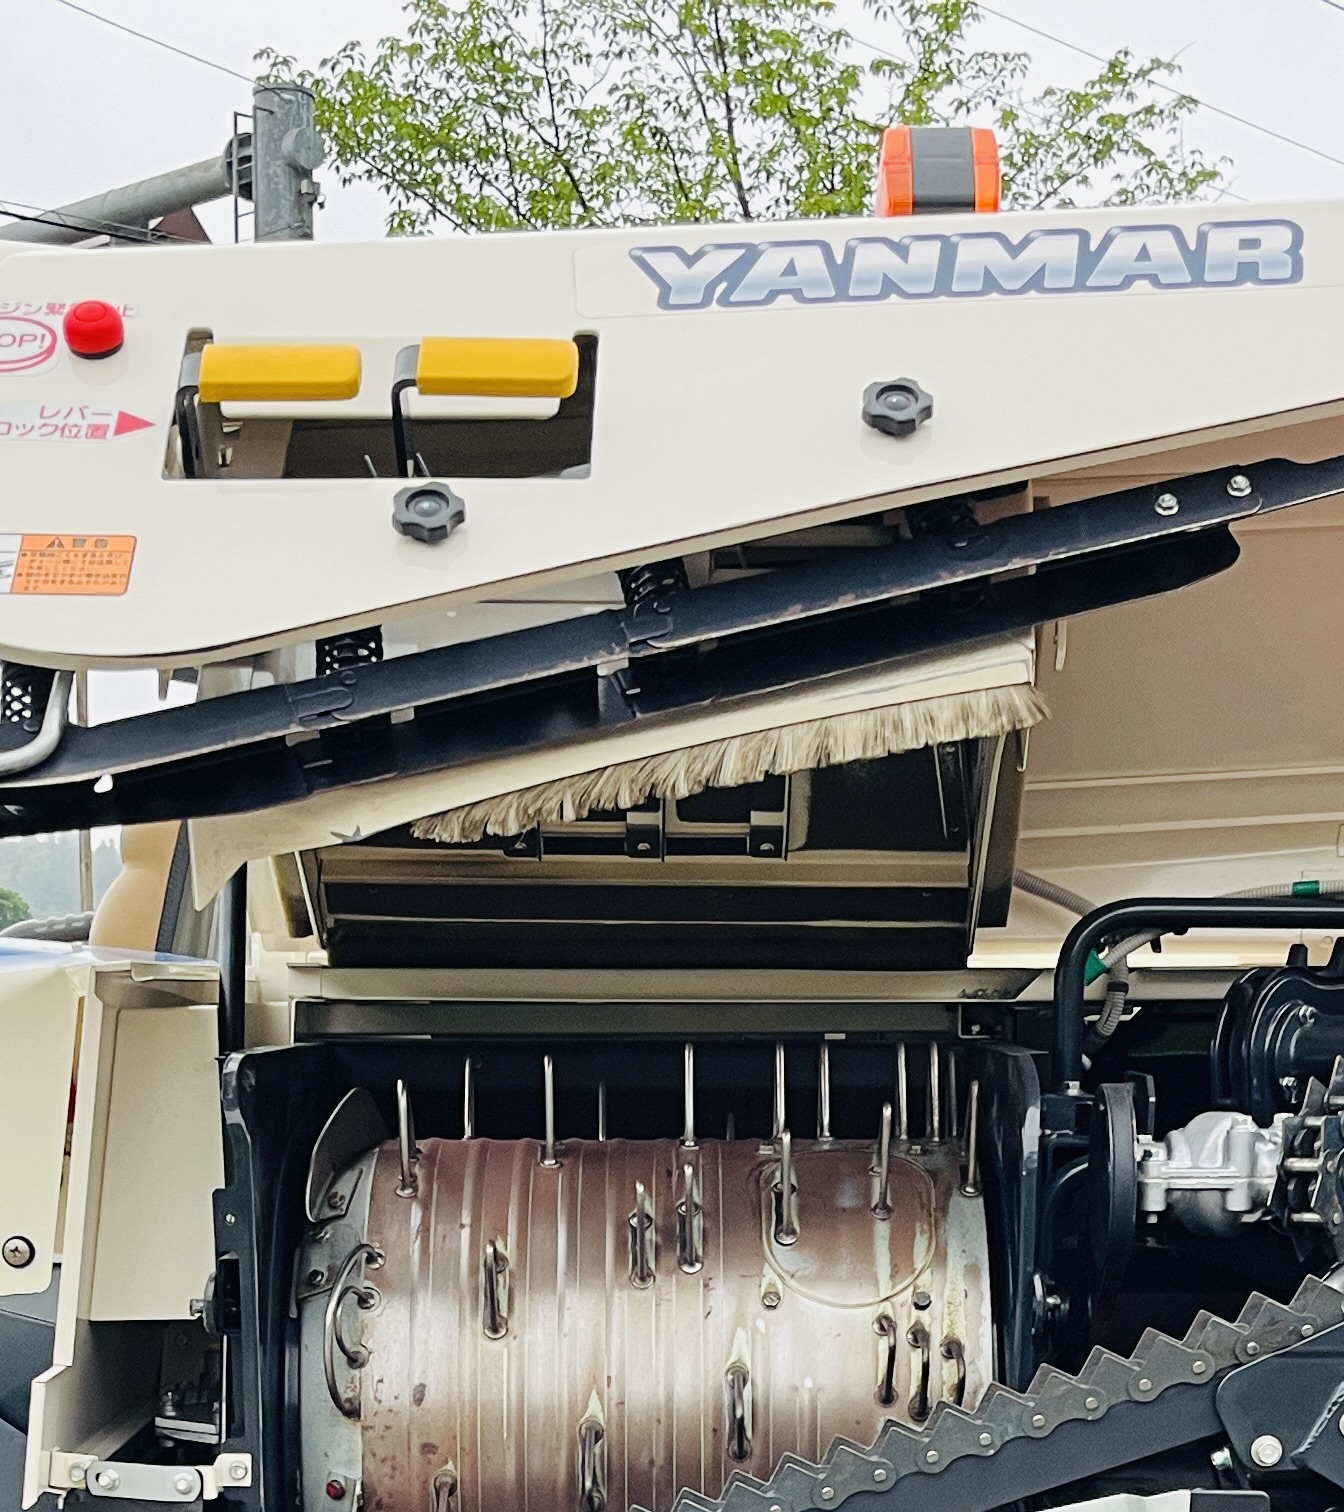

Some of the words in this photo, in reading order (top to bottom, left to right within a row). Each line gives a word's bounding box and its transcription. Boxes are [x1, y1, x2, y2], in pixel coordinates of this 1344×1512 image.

[630, 218, 1305, 310] YANMAR
[39, 405, 113, 420] レバー
